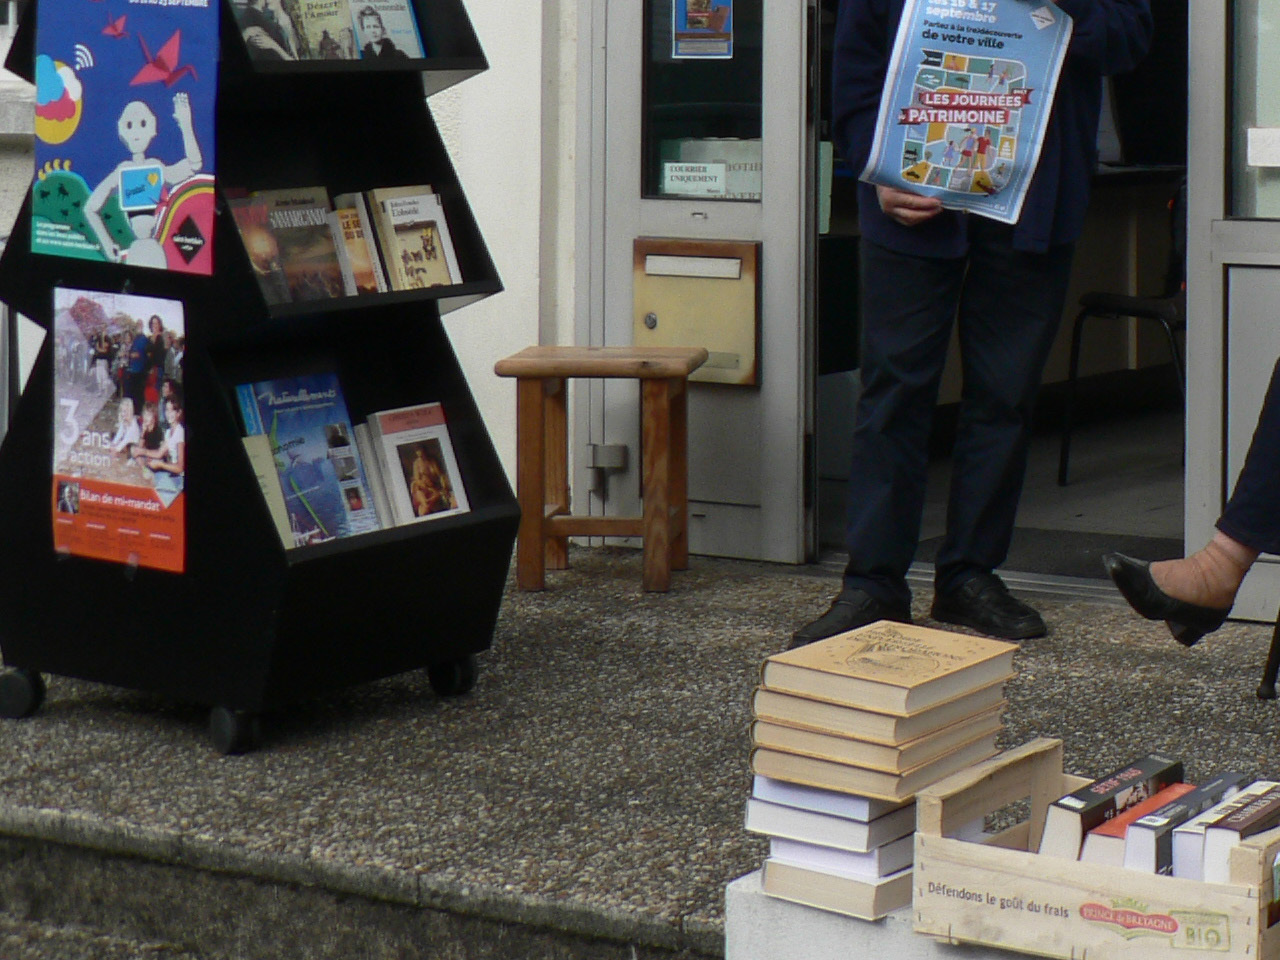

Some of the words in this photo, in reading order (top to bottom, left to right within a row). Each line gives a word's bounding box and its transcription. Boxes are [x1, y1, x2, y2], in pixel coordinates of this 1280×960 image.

[926, 6, 998, 24] septembre
[981, 1, 998, 13] 17
[922, 29, 939, 40] de
[942, 33, 975, 46] votre
[977, 37, 1005, 49] ville
[925, 93, 950, 105] LES
[908, 109, 1006, 123] PATRIMOINE
[670, 165, 707, 173] COURRIER
[670, 175, 718, 183] UNIQUEMENT
[59, 398, 80, 445] 3
[82, 430, 111, 449] ans
[80, 488, 101, 503] Bilan
[102, 493, 114, 504] de
[114, 495, 160, 512] mi-mandat
[928, 882, 983, 903] Défendons
[985, 892, 996, 905] le
[1000, 896, 1023, 913] goût
[1026, 900, 1042, 913] du
[1044, 902, 1069, 919] frais
[1084, 906, 1113, 920] PRINCE
[1125, 914, 1174, 931] BRETAGNE
[1186, 926, 1222, 947] BIO
